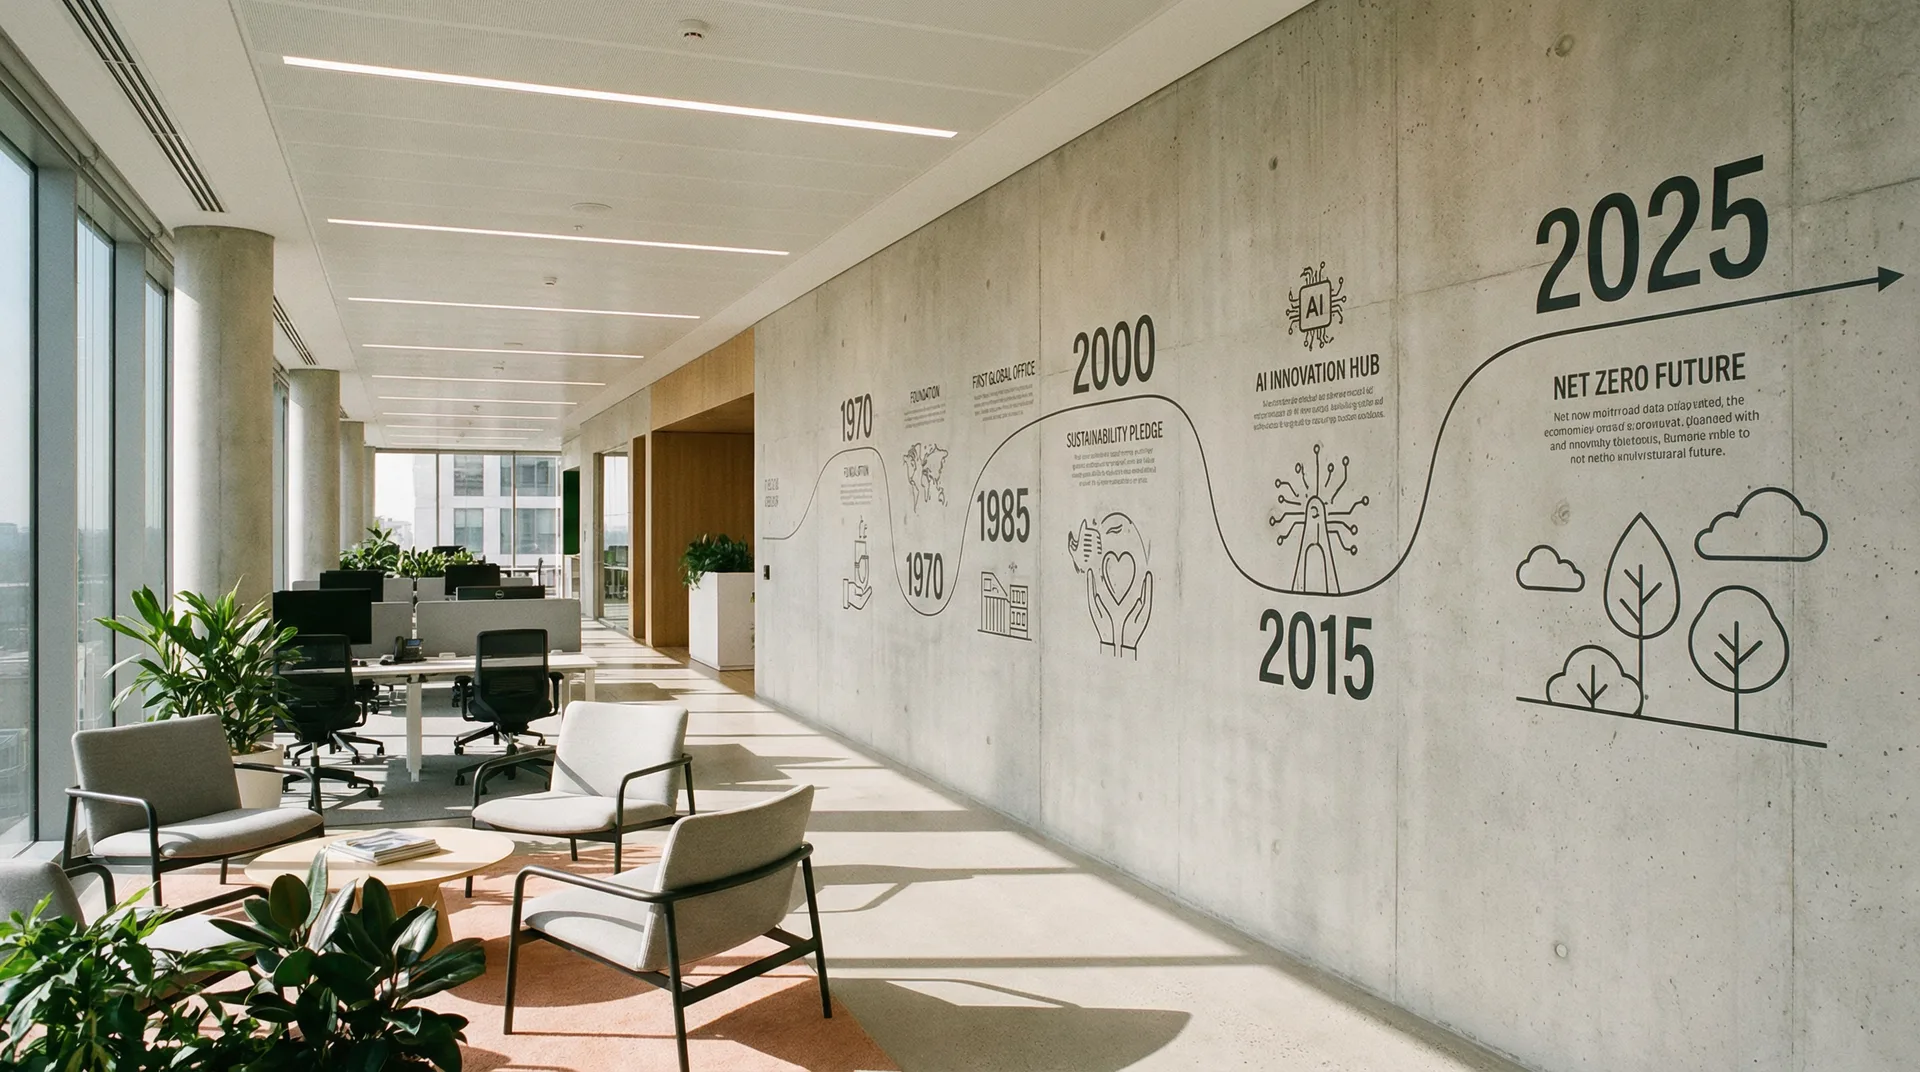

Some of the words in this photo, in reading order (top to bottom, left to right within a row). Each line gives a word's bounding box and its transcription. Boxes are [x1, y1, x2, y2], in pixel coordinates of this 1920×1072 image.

[1536, 154, 1768, 314] 2025
[1306, 294, 1323, 318] AI
[1073, 314, 1155, 395] 2000
[1256, 372, 1267, 392] AI
[1270, 359, 1346, 390] INNOVATION
[1350, 354, 1380, 378] HUB
[1553, 372, 1590, 400] NET
[1595, 364, 1649, 396] ZERO
[1655, 352, 1746, 389] FUTURE
[840, 393, 873, 442] 1970
[1553, 412, 1570, 422] Net
[1571, 411, 1590, 420] now
[1643, 404, 1664, 414] data
[1726, 395, 1745, 406] the
[1735, 410, 1759, 422] with
[1067, 426, 1127, 448] SUSTAINABILITY
[1130, 421, 1163, 441] PLEDGE
[1550, 441, 1566, 451] and
[1739, 428, 1750, 438] to
[1570, 455, 1585, 464] not
[1689, 446, 1726, 457] future.
[976, 487, 1031, 543] 1985
[906, 552, 943, 599] 1970
[1259, 608, 1374, 700] 2015
